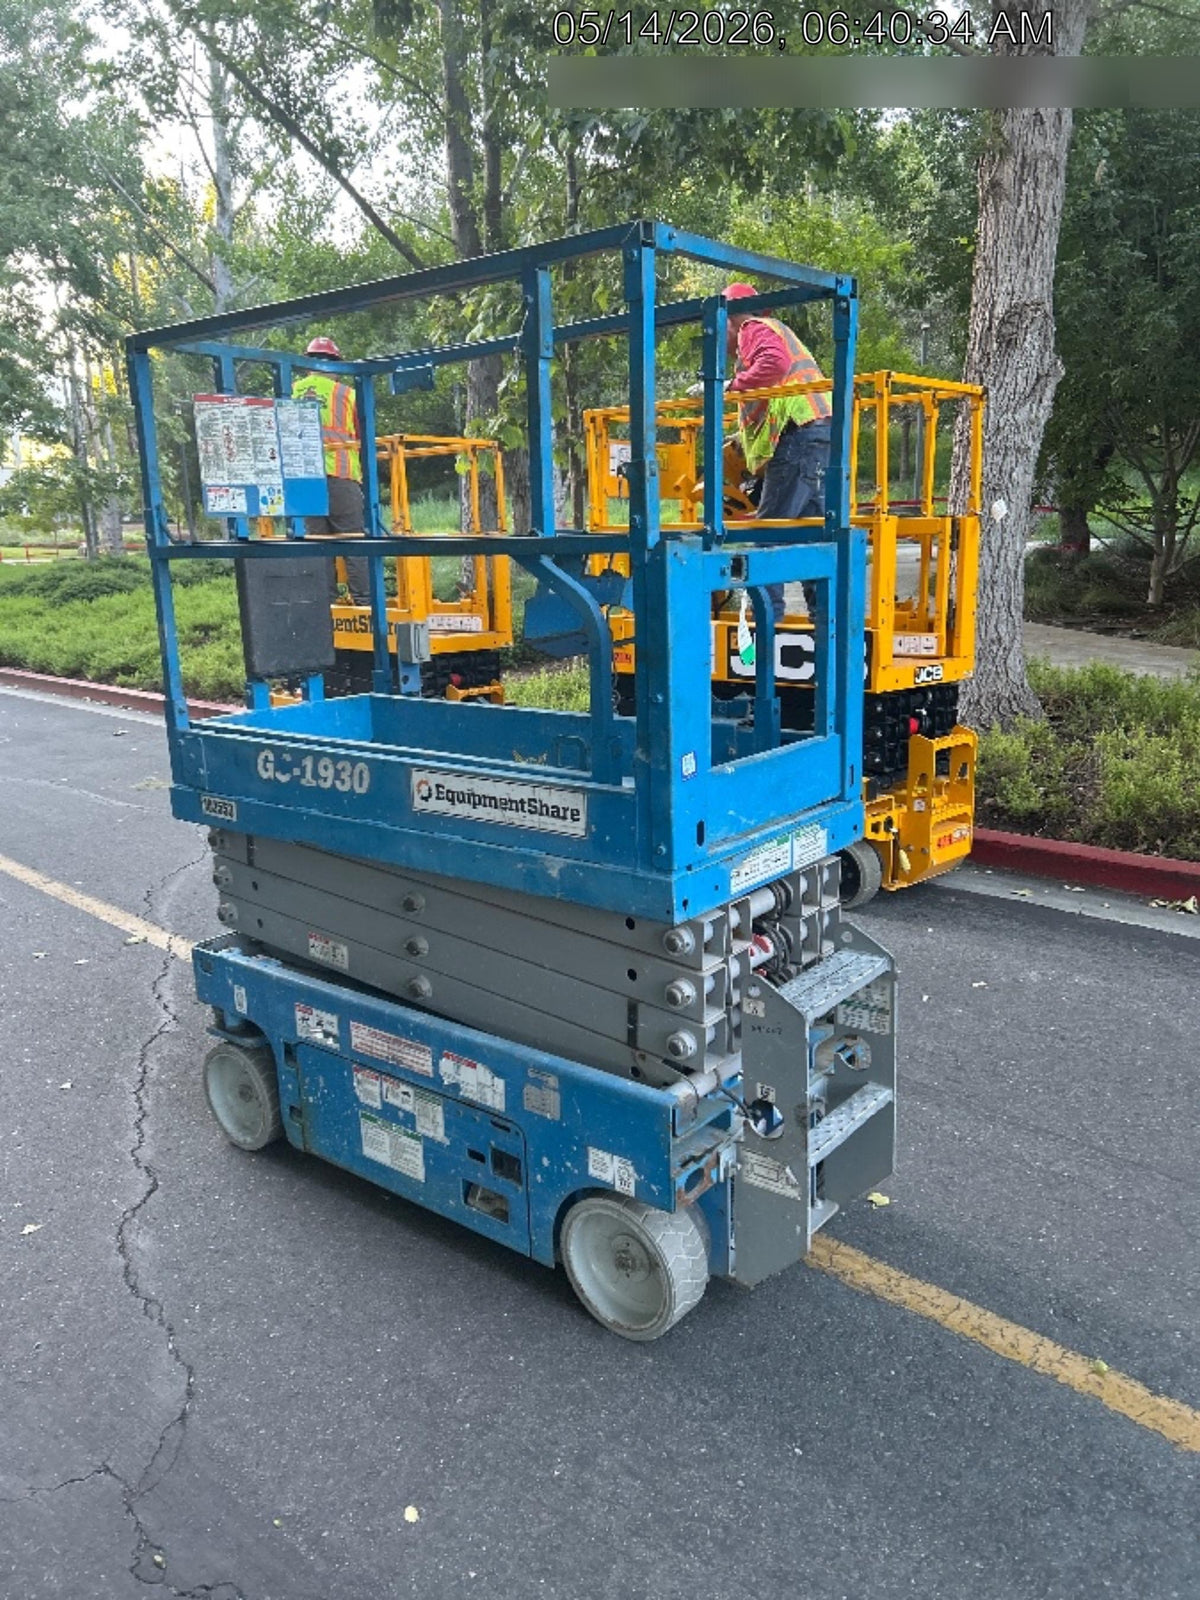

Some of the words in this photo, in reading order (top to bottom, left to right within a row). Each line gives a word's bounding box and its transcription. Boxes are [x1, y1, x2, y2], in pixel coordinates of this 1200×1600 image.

[730, 633, 868, 680] JC
[915, 665, 943, 684] JCB
[435, 783, 581, 822] EquipmentShare
